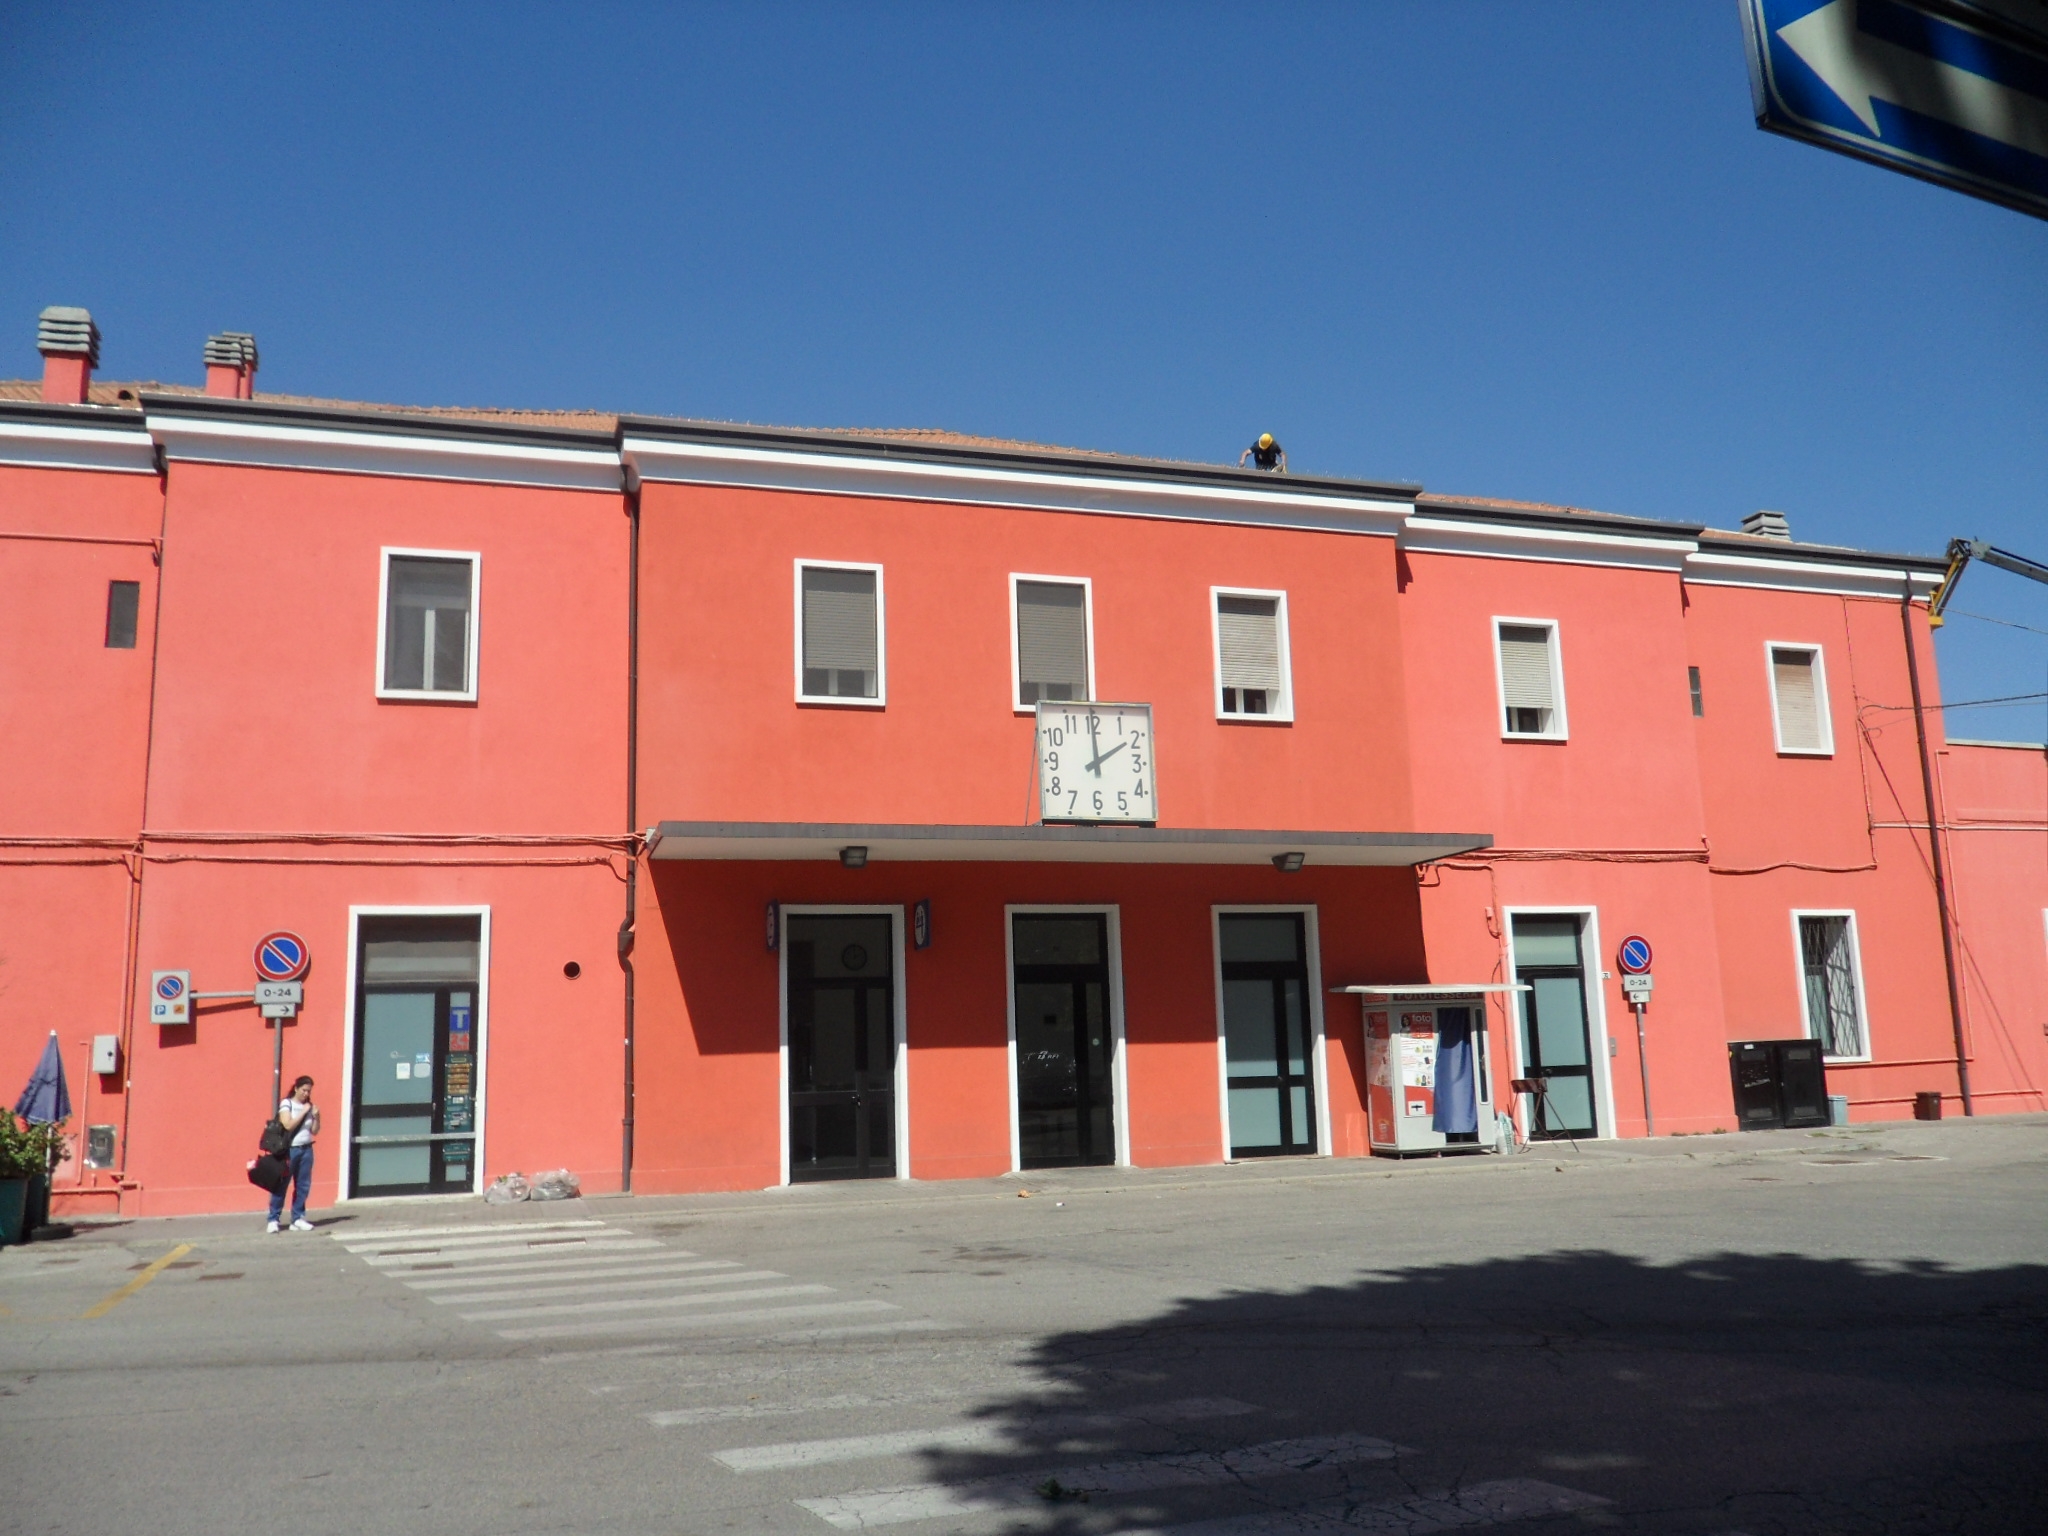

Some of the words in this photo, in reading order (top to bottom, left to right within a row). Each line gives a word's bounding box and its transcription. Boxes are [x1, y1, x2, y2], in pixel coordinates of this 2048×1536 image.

[1065, 715, 1077, 734] 11
[1085, 715, 1102, 735] 12
[1117, 716, 1123, 735] 1
[1047, 727, 1063, 747] 10
[1130, 730, 1141, 749] 2
[1048, 751, 1059, 771] 9
[1131, 754, 1142, 773] 3
[1051, 776, 1061, 796] 8
[1134, 778, 1144, 798] 4
[1068, 790, 1078, 810] 7
[1093, 791, 1103, 810] 6
[1117, 791, 1127, 811] 5
[264, 988, 292, 997] 0-24
[452, 1009, 469, 1029] T
[1411, 1014, 1432, 1023] foto
